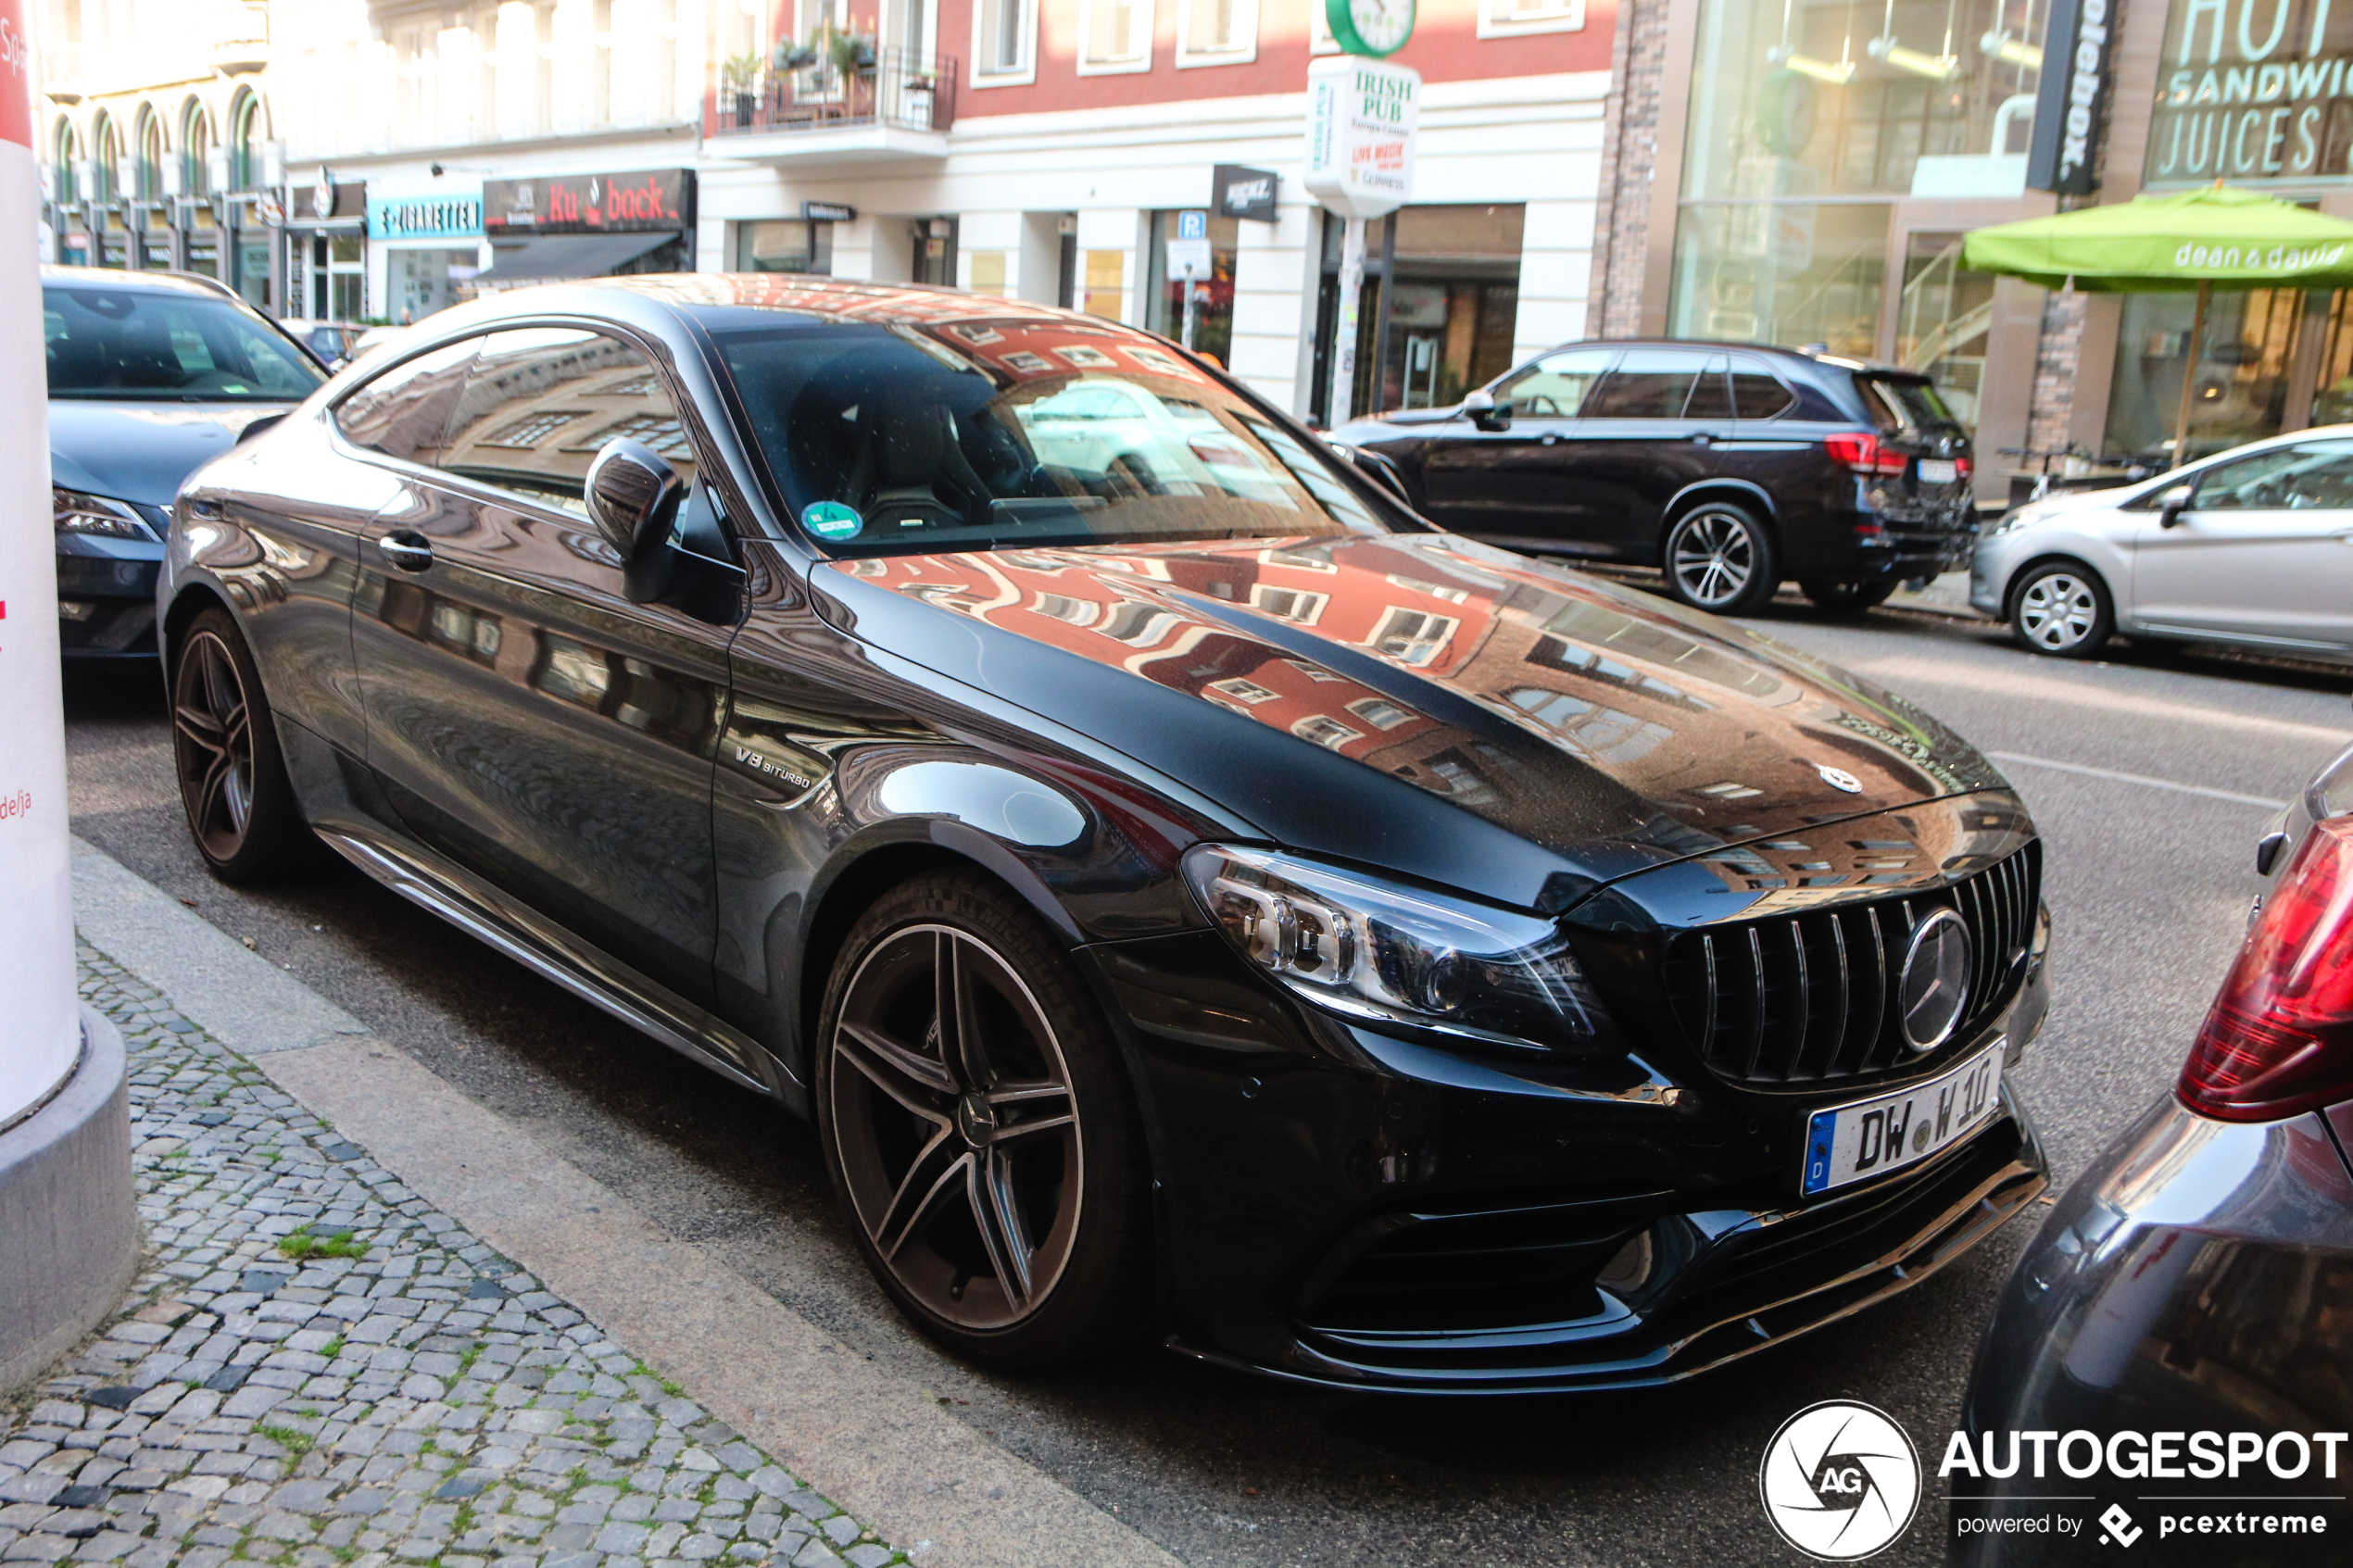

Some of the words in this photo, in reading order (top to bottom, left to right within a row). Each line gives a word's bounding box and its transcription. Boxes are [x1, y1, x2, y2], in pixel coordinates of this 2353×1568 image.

[1356, 70, 1412, 102] IRISH
[2166, 58, 2353, 107] SANDWI
[1363, 95, 1402, 123] PUB
[2158, 105, 2321, 174] JUICES
[380, 199, 479, 232] E-ZIGARETTEN
[549, 184, 579, 223] Ku
[607, 177, 664, 221] back
[2175, 240, 2240, 269] dean
[2267, 243, 2346, 270] david
[736, 746, 762, 769] V8
[762, 762, 811, 789] BITURBO
[1856, 1099, 1913, 1173] DW
[1958, 1058, 1991, 1129] 10
[1812, 1161, 1823, 1180] D
